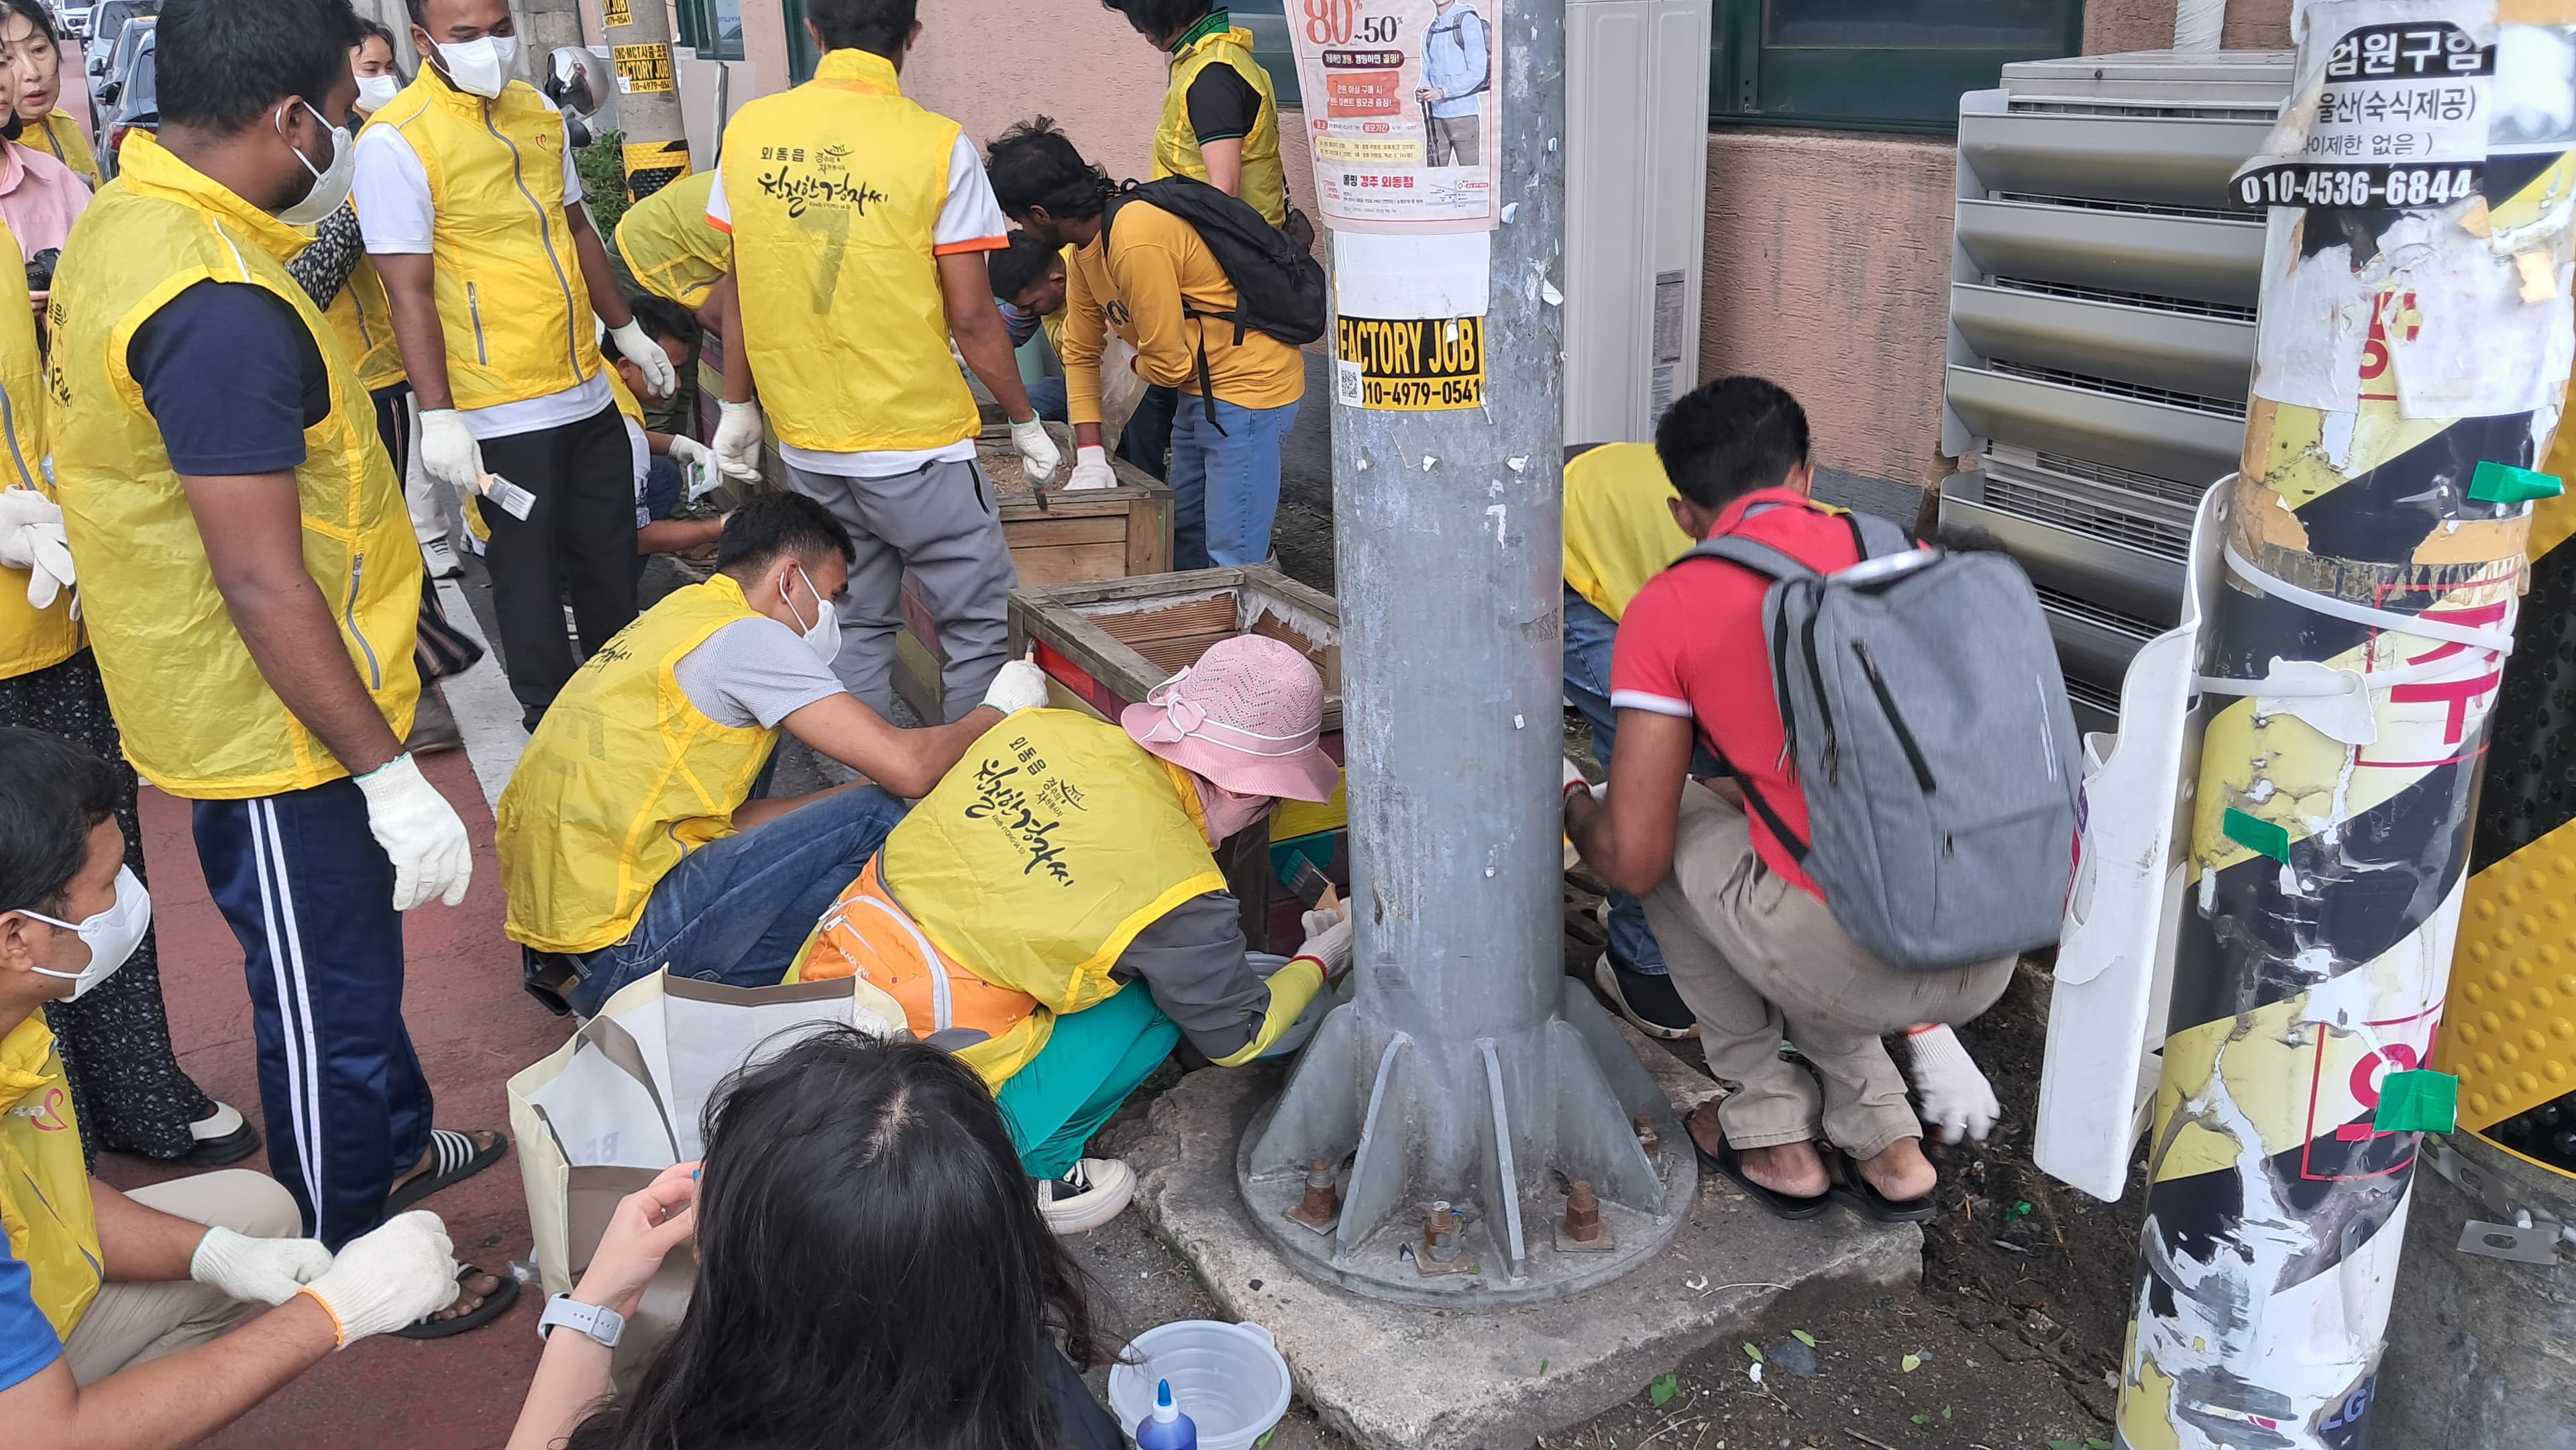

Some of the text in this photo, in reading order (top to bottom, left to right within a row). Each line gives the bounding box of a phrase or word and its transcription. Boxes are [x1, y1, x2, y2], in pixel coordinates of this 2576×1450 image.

[618, 59, 669, 80] FACTORY JOB
[1348, 85, 1360, 94] 이상
[1376, 85, 1383, 94] 시
[1356, 98, 1374, 107] 응모권
[1376, 98, 1392, 107] 증정!
[2317, 85, 2475, 125] 울산(숙식제공)
[1364, 123, 1388, 132] 응모기간
[760, 146, 805, 162] 외동읍
[1343, 174, 1414, 189] 콜핑 경주 외동점
[2241, 168, 2473, 206] 010-4536-6844
[1340, 319, 1476, 374] FACTORY JOB
[1008, 736, 1046, 776] 외동읍
